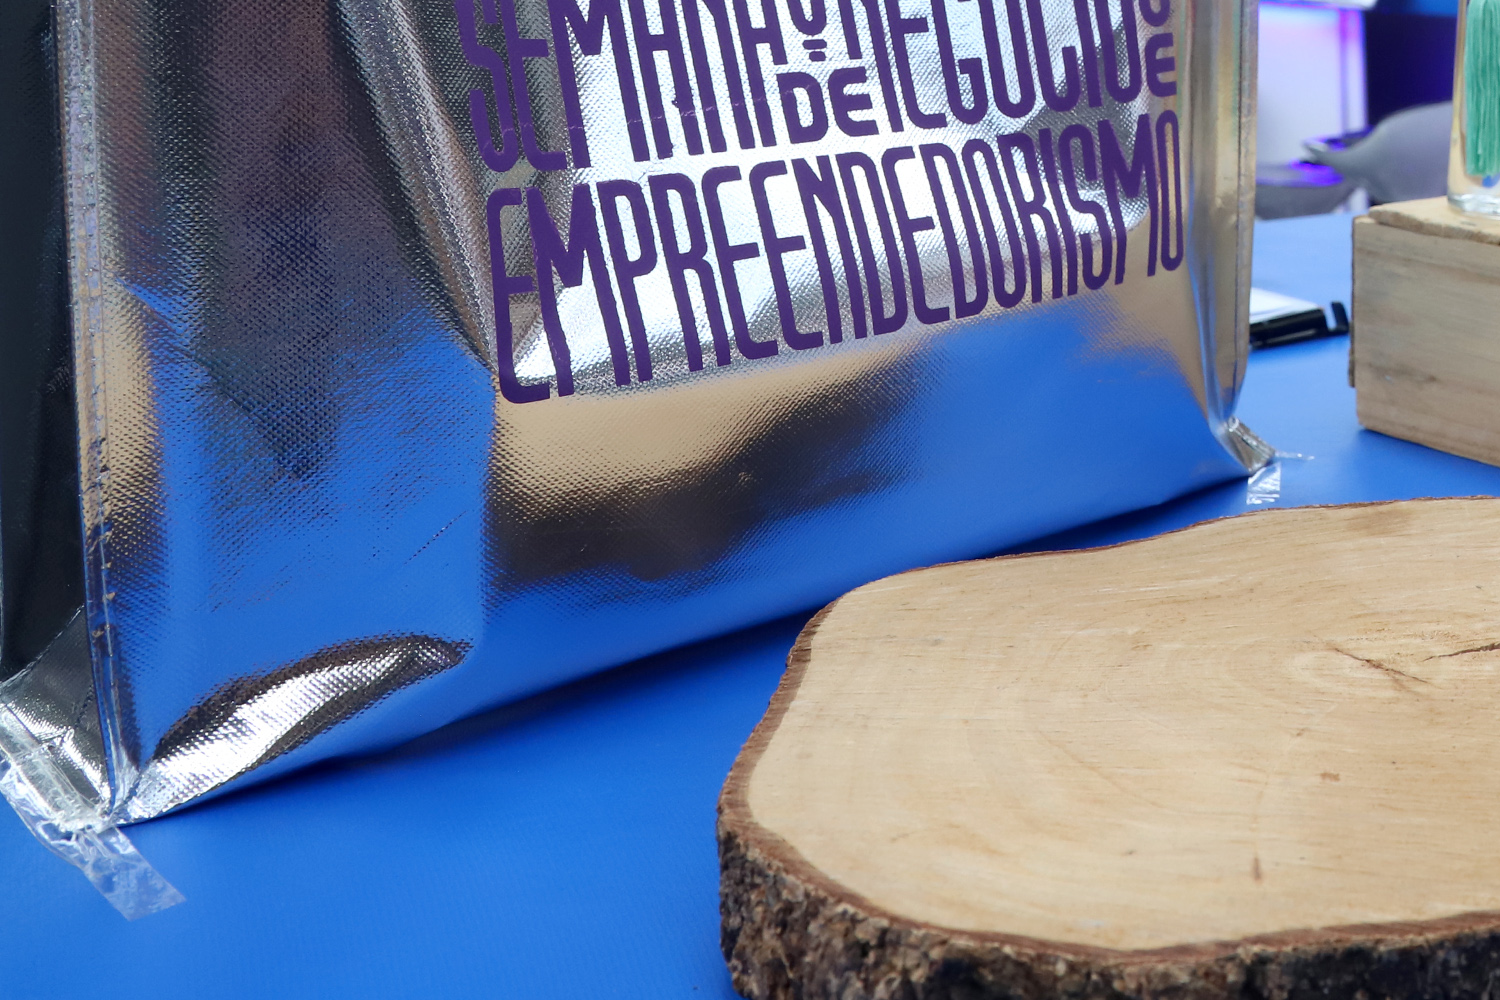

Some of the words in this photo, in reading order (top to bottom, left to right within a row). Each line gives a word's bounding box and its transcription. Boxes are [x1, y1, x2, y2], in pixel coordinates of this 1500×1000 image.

[776, 67, 878, 144] DE
[1145, 33, 1177, 98] E
[486, 110, 1184, 404] EMPREENDEDORISMO
